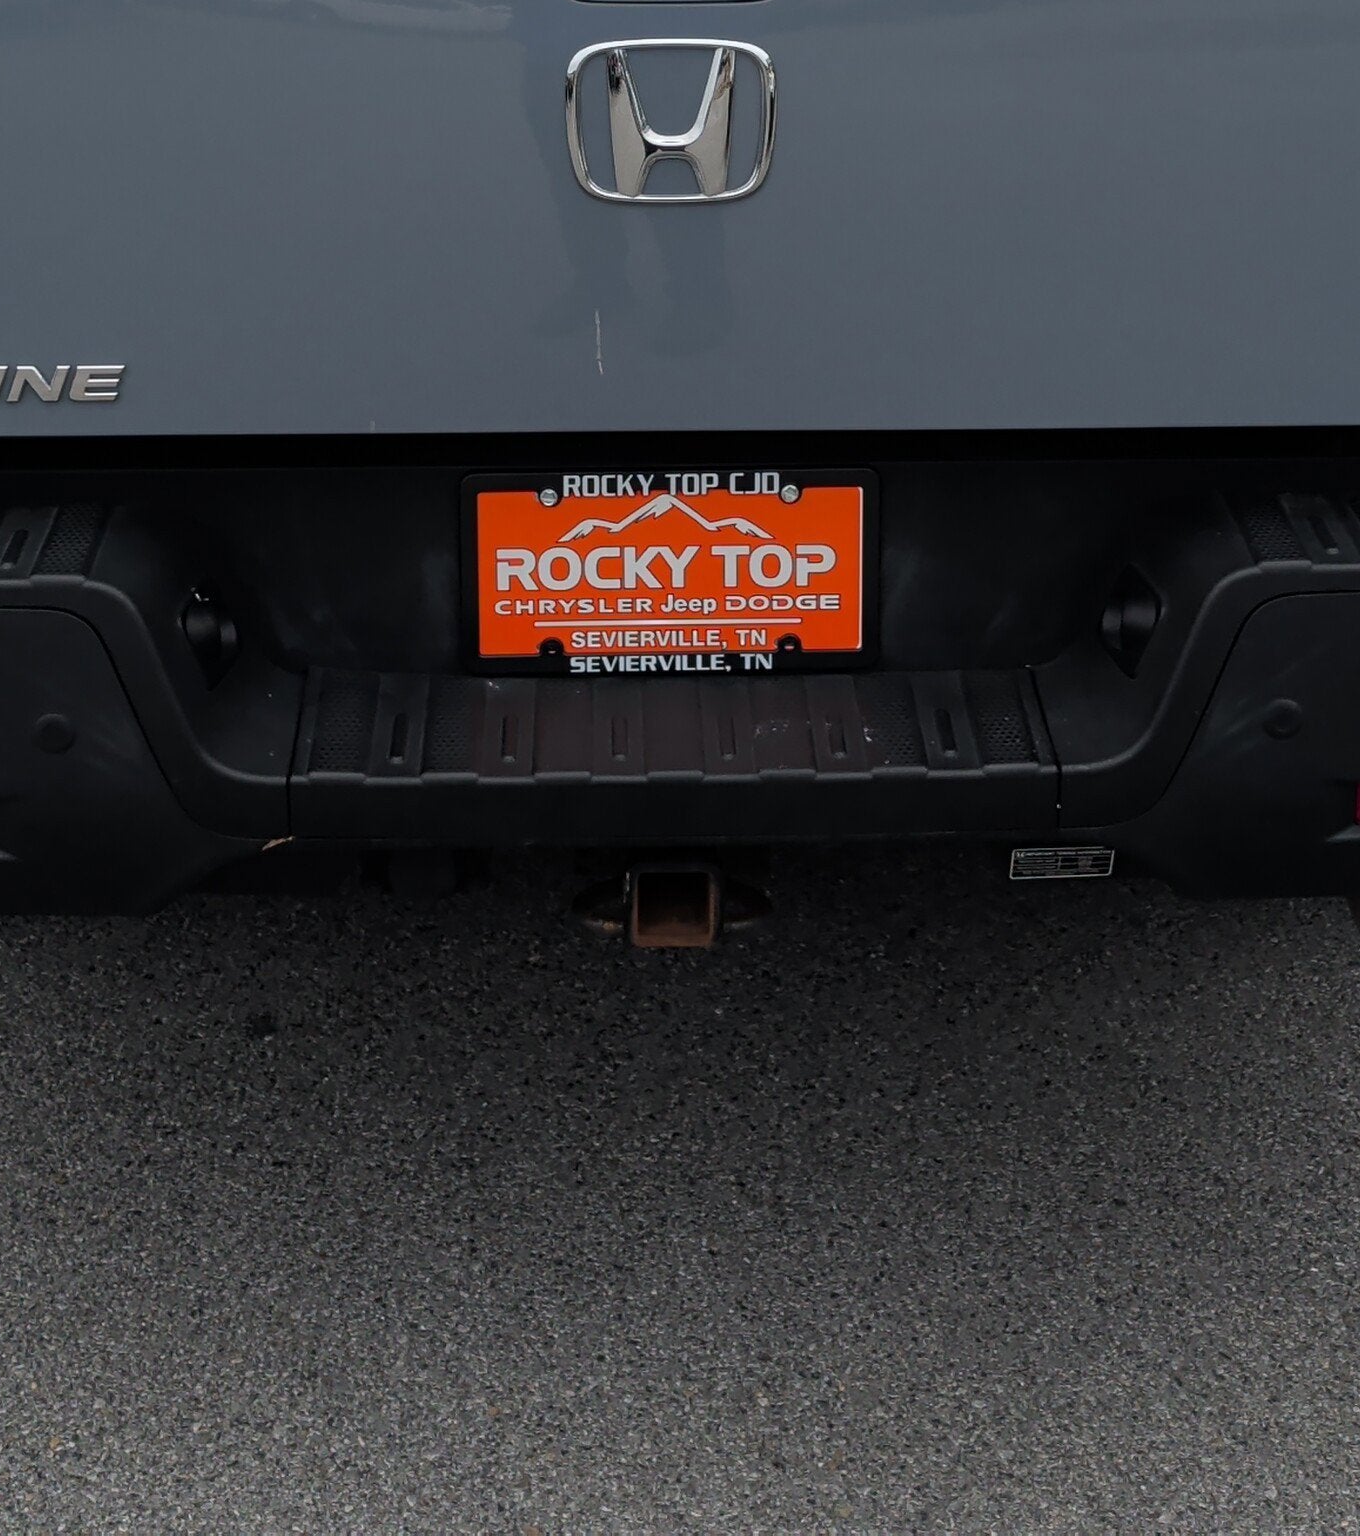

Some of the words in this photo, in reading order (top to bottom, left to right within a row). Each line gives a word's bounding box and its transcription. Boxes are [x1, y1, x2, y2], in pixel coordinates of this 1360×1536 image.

[563, 474, 655, 497] ROCKY
[665, 472, 719, 496] TOP
[729, 472, 780, 495] CJD
[495, 545, 702, 592] ROCKY
[711, 544, 837, 588] TOP
[494, 597, 654, 615] CHRYSLER
[659, 593, 717, 614] Jeep
[724, 594, 841, 612] DODGE
[570, 629, 728, 650] SEVIERVILLE,
[736, 629, 767, 647] TN
[569, 653, 731, 674] SEVIERVILLE,
[741, 652, 773, 671] TN
